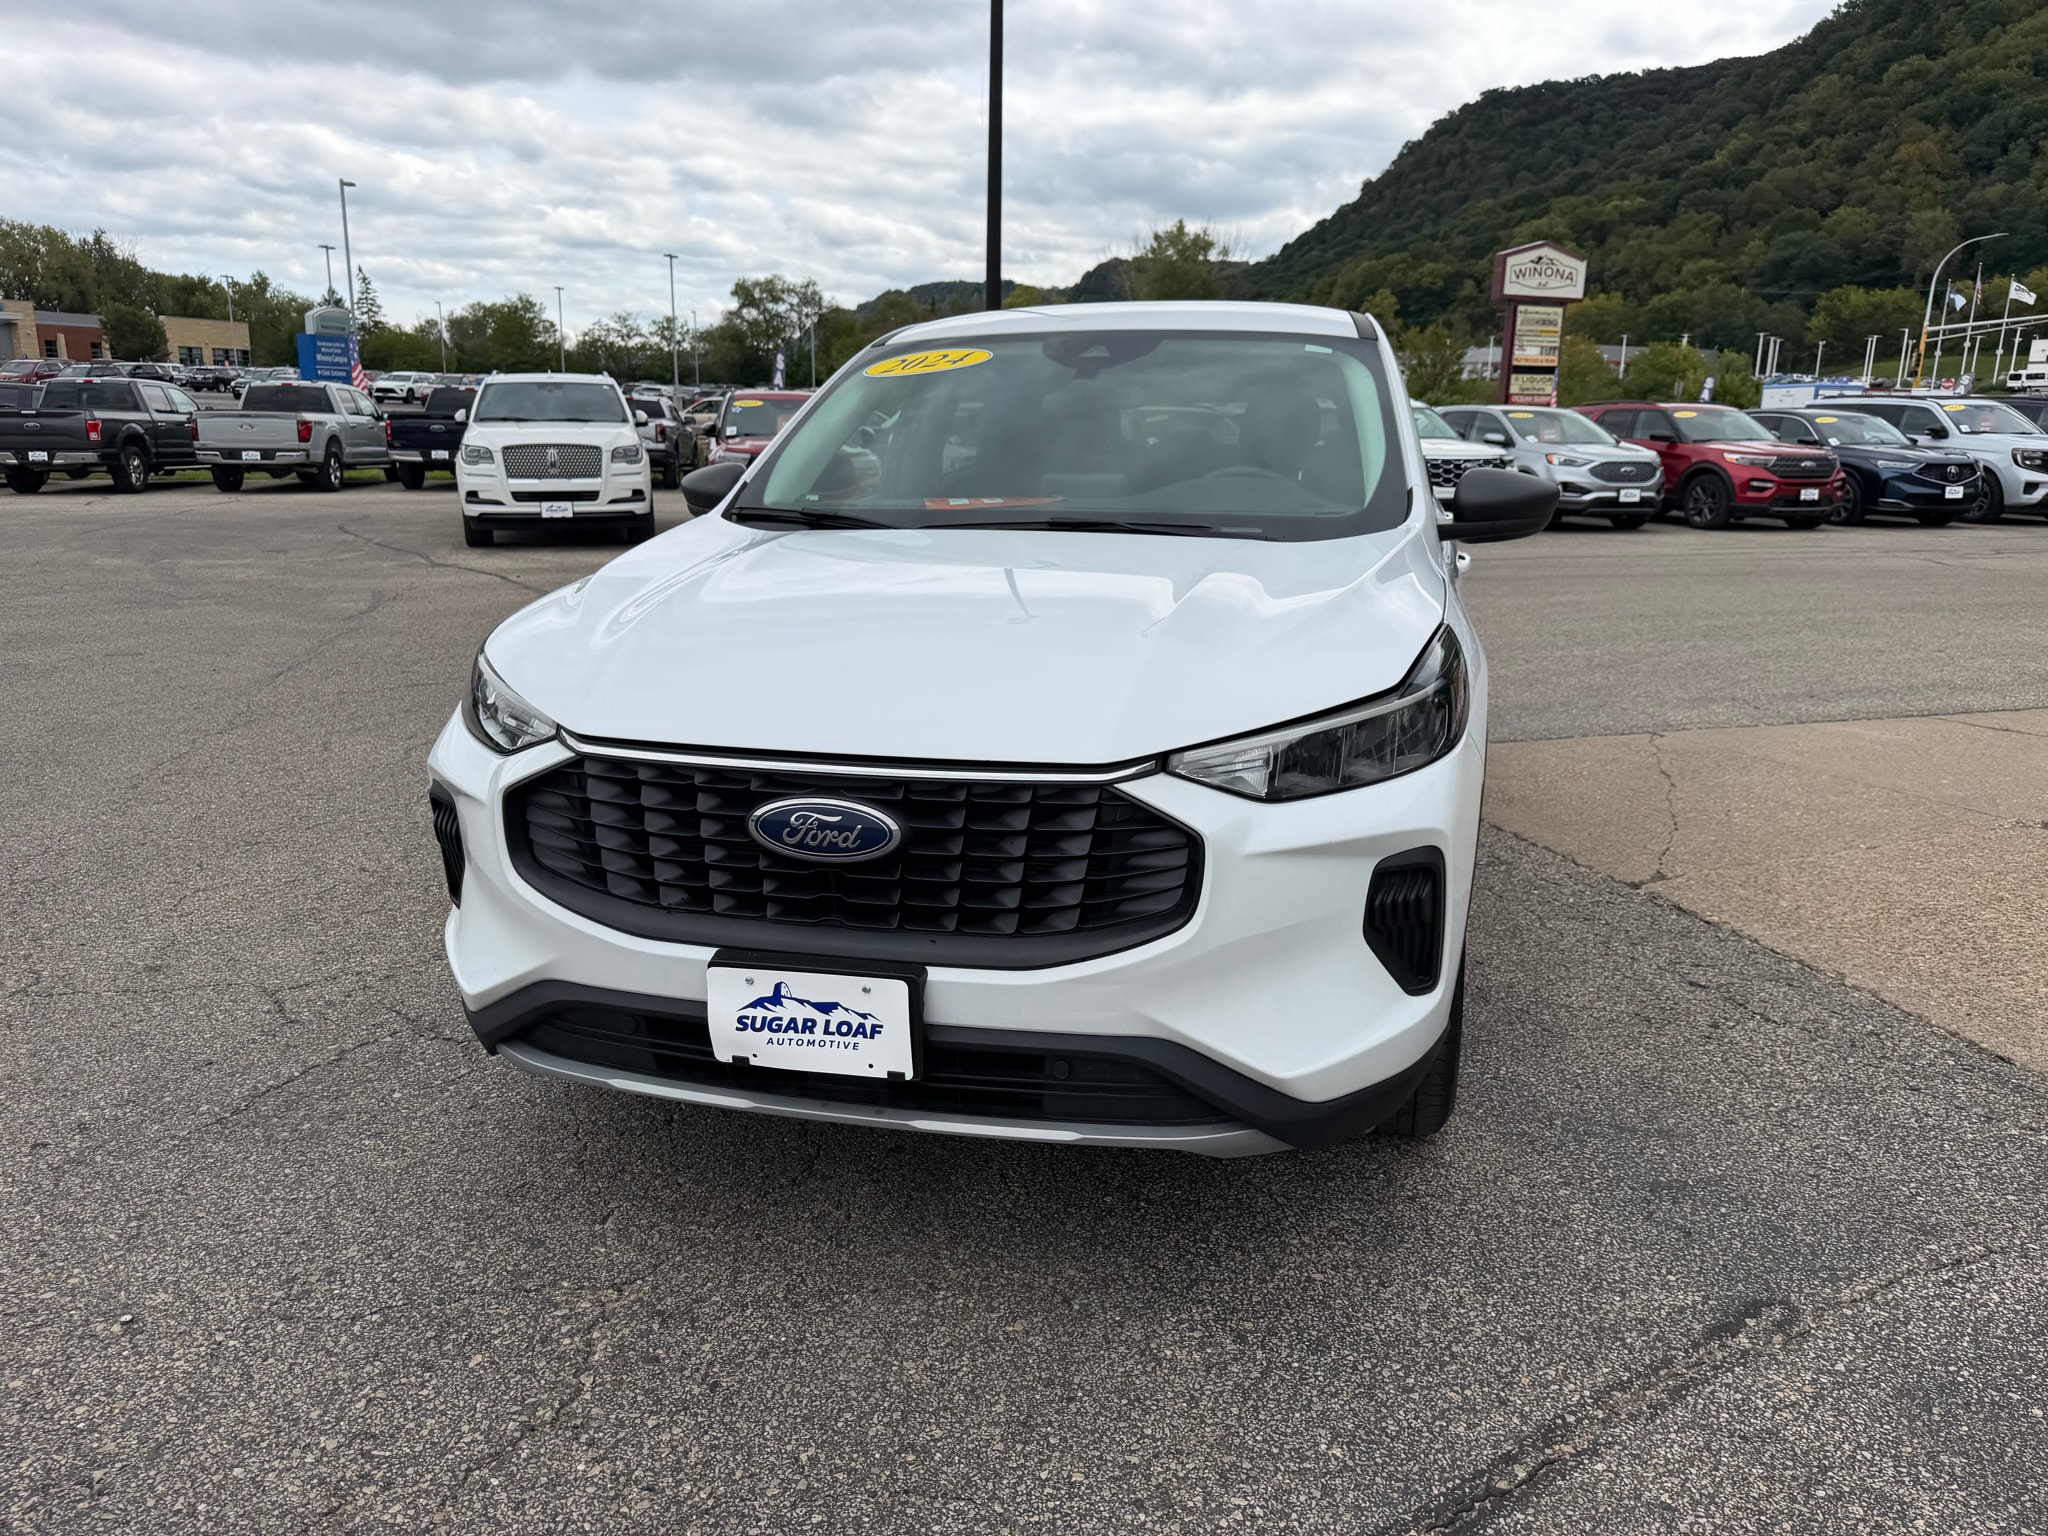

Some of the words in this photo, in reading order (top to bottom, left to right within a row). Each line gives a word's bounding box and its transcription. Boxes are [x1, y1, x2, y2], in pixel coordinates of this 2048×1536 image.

[1513, 266, 1574, 283] WINONA
[878, 351, 976, 374] 2024
[1700, 376, 1715, 402] SA
[1955, 374, 1970, 396] SA
[782, 811, 862, 848] Ford
[735, 1014, 818, 1036] SUGAR
[823, 1018, 884, 1040] LOAF
[766, 1036, 860, 1051] AUTOMOTIVE
